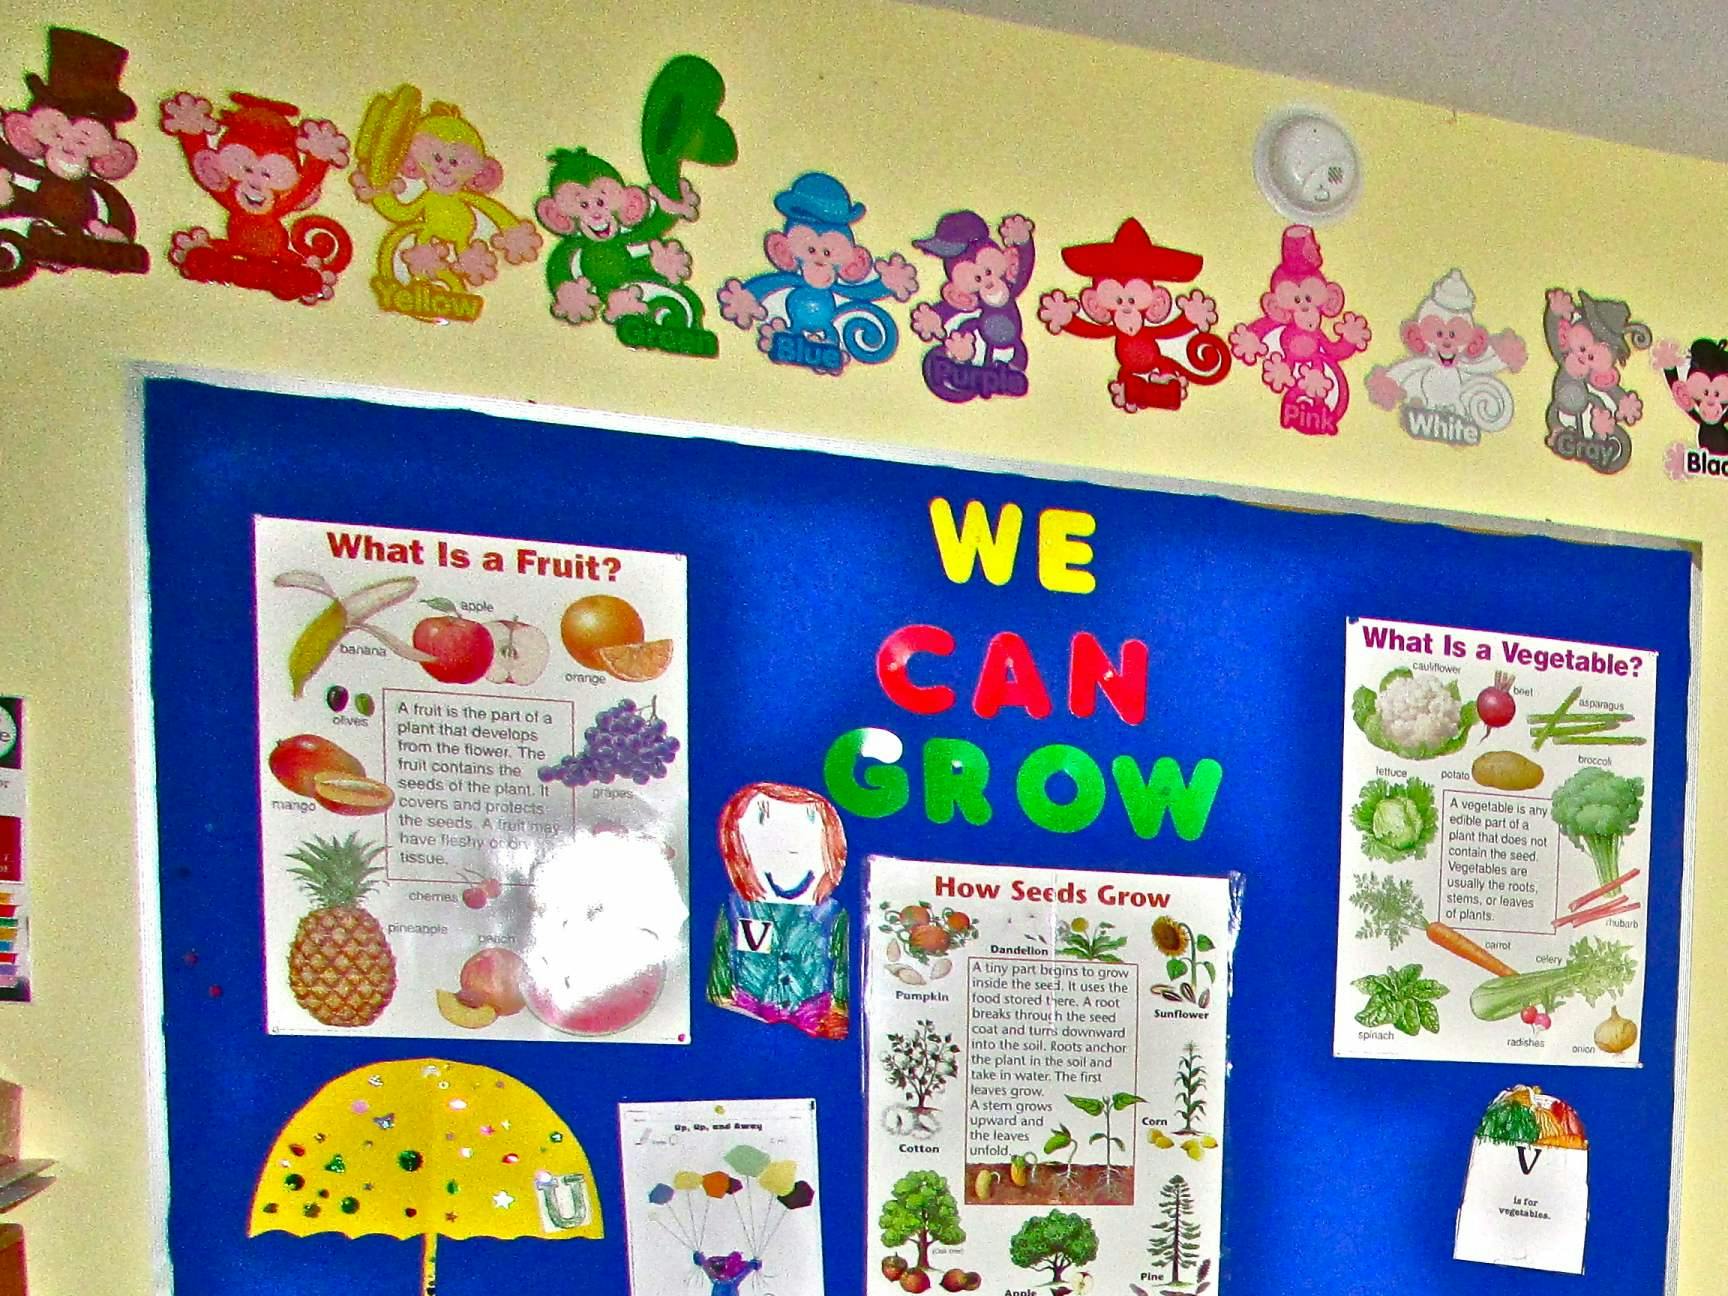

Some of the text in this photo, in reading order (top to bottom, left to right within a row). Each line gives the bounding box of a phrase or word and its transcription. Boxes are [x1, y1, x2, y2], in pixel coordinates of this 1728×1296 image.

[380, 279, 478, 317] Yellow
[775, 335, 841, 367] Blue
[1284, 403, 1333, 432] Pink
[1408, 411, 1479, 444] White
[1557, 433, 1614, 466] Gray
[930, 497, 1096, 594] WE
[326, 531, 622, 582] What Is a Fruit?
[461, 600, 494, 613] apple
[338, 643, 387, 657] banana
[1362, 625, 1643, 677] What Is a Vegetable?
[1412, 661, 1461, 674] cauliflower
[565, 672, 607, 686] orange
[875, 624, 1149, 726] CAN
[1513, 686, 1534, 697] beet
[1578, 699, 1625, 711] asparagus
[397, 702, 553, 725] A fruit is the part of a
[332, 714, 369, 727] olives
[1578, 755, 1612, 766] broccoli
[1376, 766, 1408, 778] lettuce
[1441, 768, 1471, 781] potato
[824, 727, 1223, 842] GROW
[592, 788, 634, 800] grapes
[272, 800, 317, 814] mango
[1449, 797, 1548, 819] A vegetable is any
[1449, 815, 1530, 831] edible part of a
[1449, 830, 1548, 848] plant that does not
[935, 875, 1171, 909] How Seeds Grow
[388, 923, 449, 936] pineapple
[1605, 918, 1639, 930] rhubarb
[740, 919, 772, 951] V
[990, 944, 1049, 957] Dandelion
[1485, 939, 1511, 950] carrot
[1535, 954, 1562, 966] celery
[895, 990, 950, 1004] Pumpkin
[1153, 1008, 1209, 1022] Sunflower
[1358, 1030, 1395, 1042] spinach
[1507, 1037, 1545, 1049] radishes
[1572, 1045, 1596, 1054] onion
[971, 1054, 1112, 1068] the plant in the soil and
[971, 1070, 1102, 1083] take in water. The first
[970, 1100, 1053, 1114] A stem grows
[734, 1123, 762, 1132] Away
[970, 1115, 1044, 1127] upward and
[1142, 1116, 1168, 1127] Corn
[970, 1130, 1030, 1141] the leaves
[899, 1143, 940, 1154] Cotton
[970, 1145, 1012, 1156] unfold.
[1517, 1146, 1542, 1175] V
[1513, 1196, 1539, 1208] is for
[1499, 1207, 1551, 1220] vegetables.
[1140, 1272, 1164, 1281] Pine
